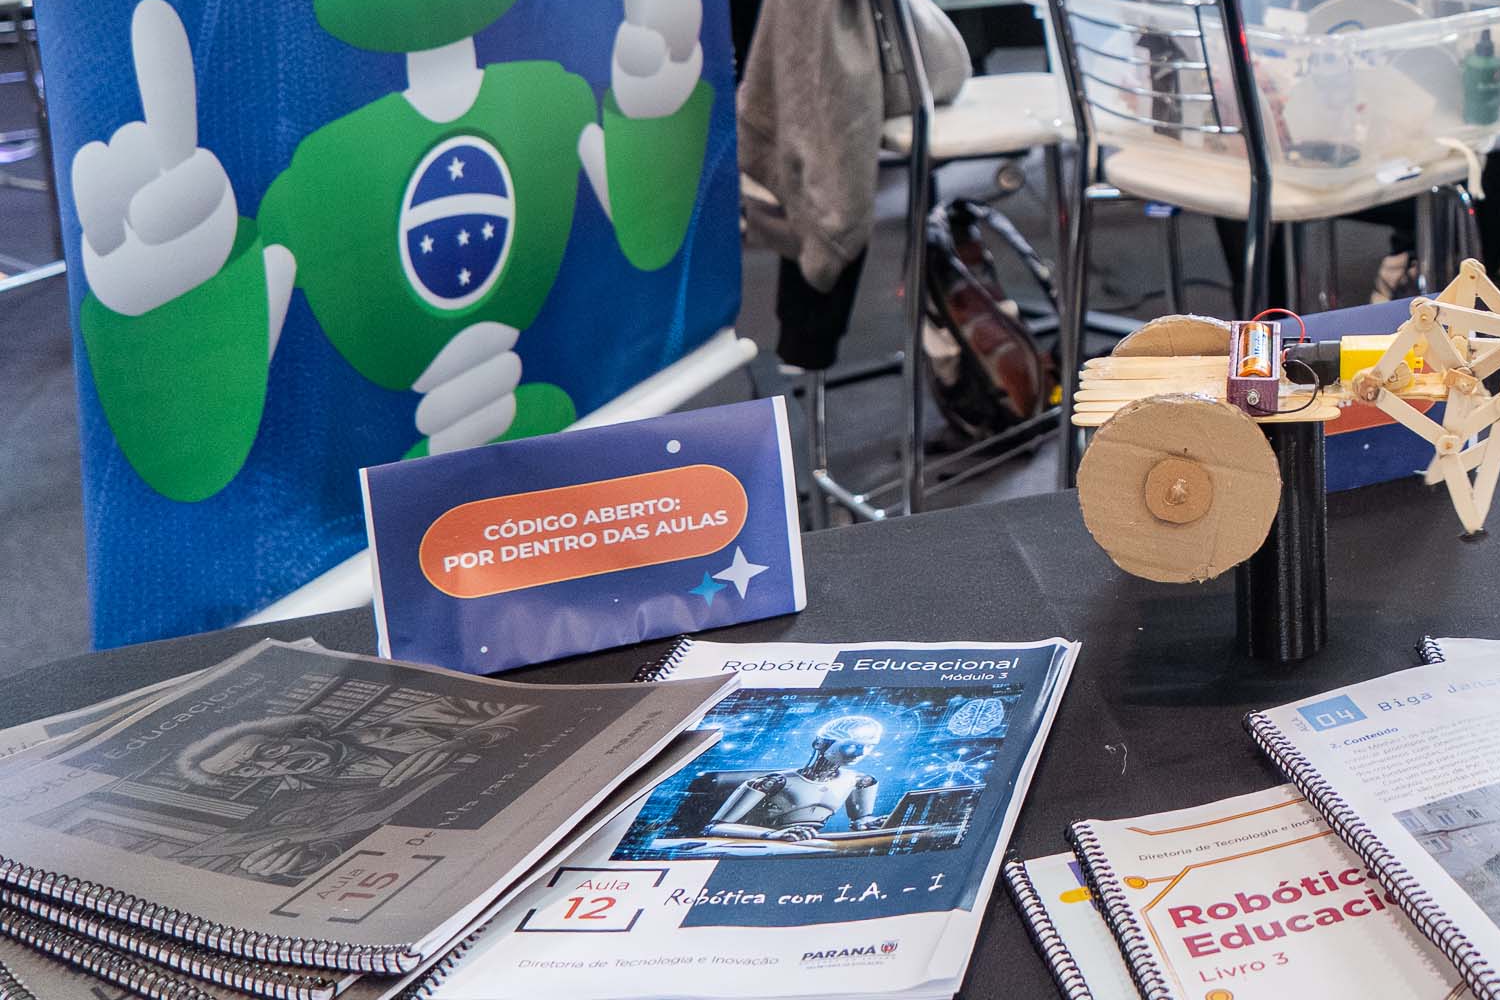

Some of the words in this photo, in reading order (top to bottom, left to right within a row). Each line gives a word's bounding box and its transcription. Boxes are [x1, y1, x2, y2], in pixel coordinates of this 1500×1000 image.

[484, 512, 577, 541] CÓDIGO
[583, 497, 681, 526] ABERTO:
[443, 549, 494, 573] POR
[500, 532, 597, 563] DENTRO
[603, 523, 650, 545] DAS
[655, 510, 729, 536] AULAS
[721, 658, 844, 673] Robótica
[853, 656, 1020, 671] Educacional
[940, 672, 995, 682] Módulo
[998, 672, 1009, 680] 3
[1316, 709, 1355, 727] 04
[1378, 691, 1433, 712] Biga
[1138, 847, 1192, 862] Diretoria
[1195, 843, 1211, 852] de
[1214, 828, 1278, 848] Tecnologia
[317, 869, 365, 899] Aula
[338, 872, 399, 901] 15
[575, 879, 630, 891] Aula
[664, 887, 765, 906] Robótica
[778, 893, 823, 905] com
[833, 884, 887, 903] I.A.
[928, 873, 946, 891] I
[564, 896, 618, 920] 12
[516, 958, 585, 969] Diretoria
[589, 959, 608, 968] de
[615, 955, 693, 968] Tecnologia
[697, 956, 706, 964] e
[711, 955, 780, 967] Inovação
[801, 944, 876, 961] PARANÁ
[1199, 959, 1266, 982] Livro
[1272, 952, 1289, 966] 3
